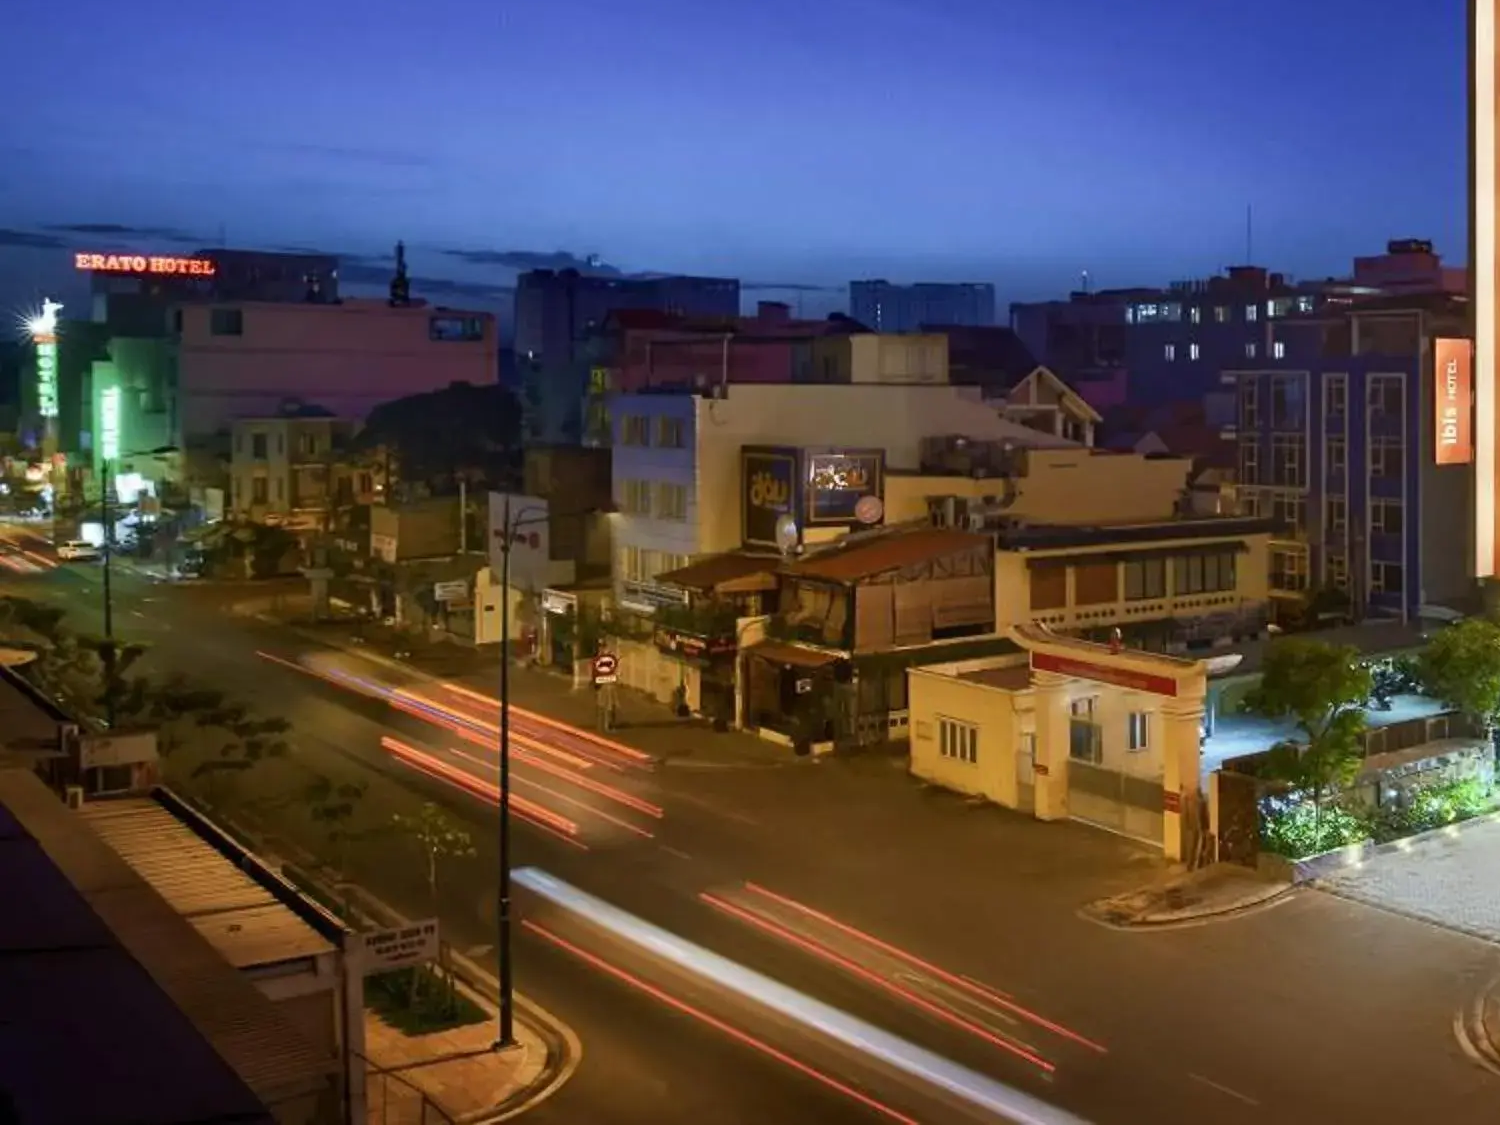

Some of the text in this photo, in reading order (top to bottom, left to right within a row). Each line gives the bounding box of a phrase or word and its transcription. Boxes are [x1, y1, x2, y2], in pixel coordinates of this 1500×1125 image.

[75, 253, 215, 274] ERATO HOTEL
[1440, 407, 1457, 444] ibis
